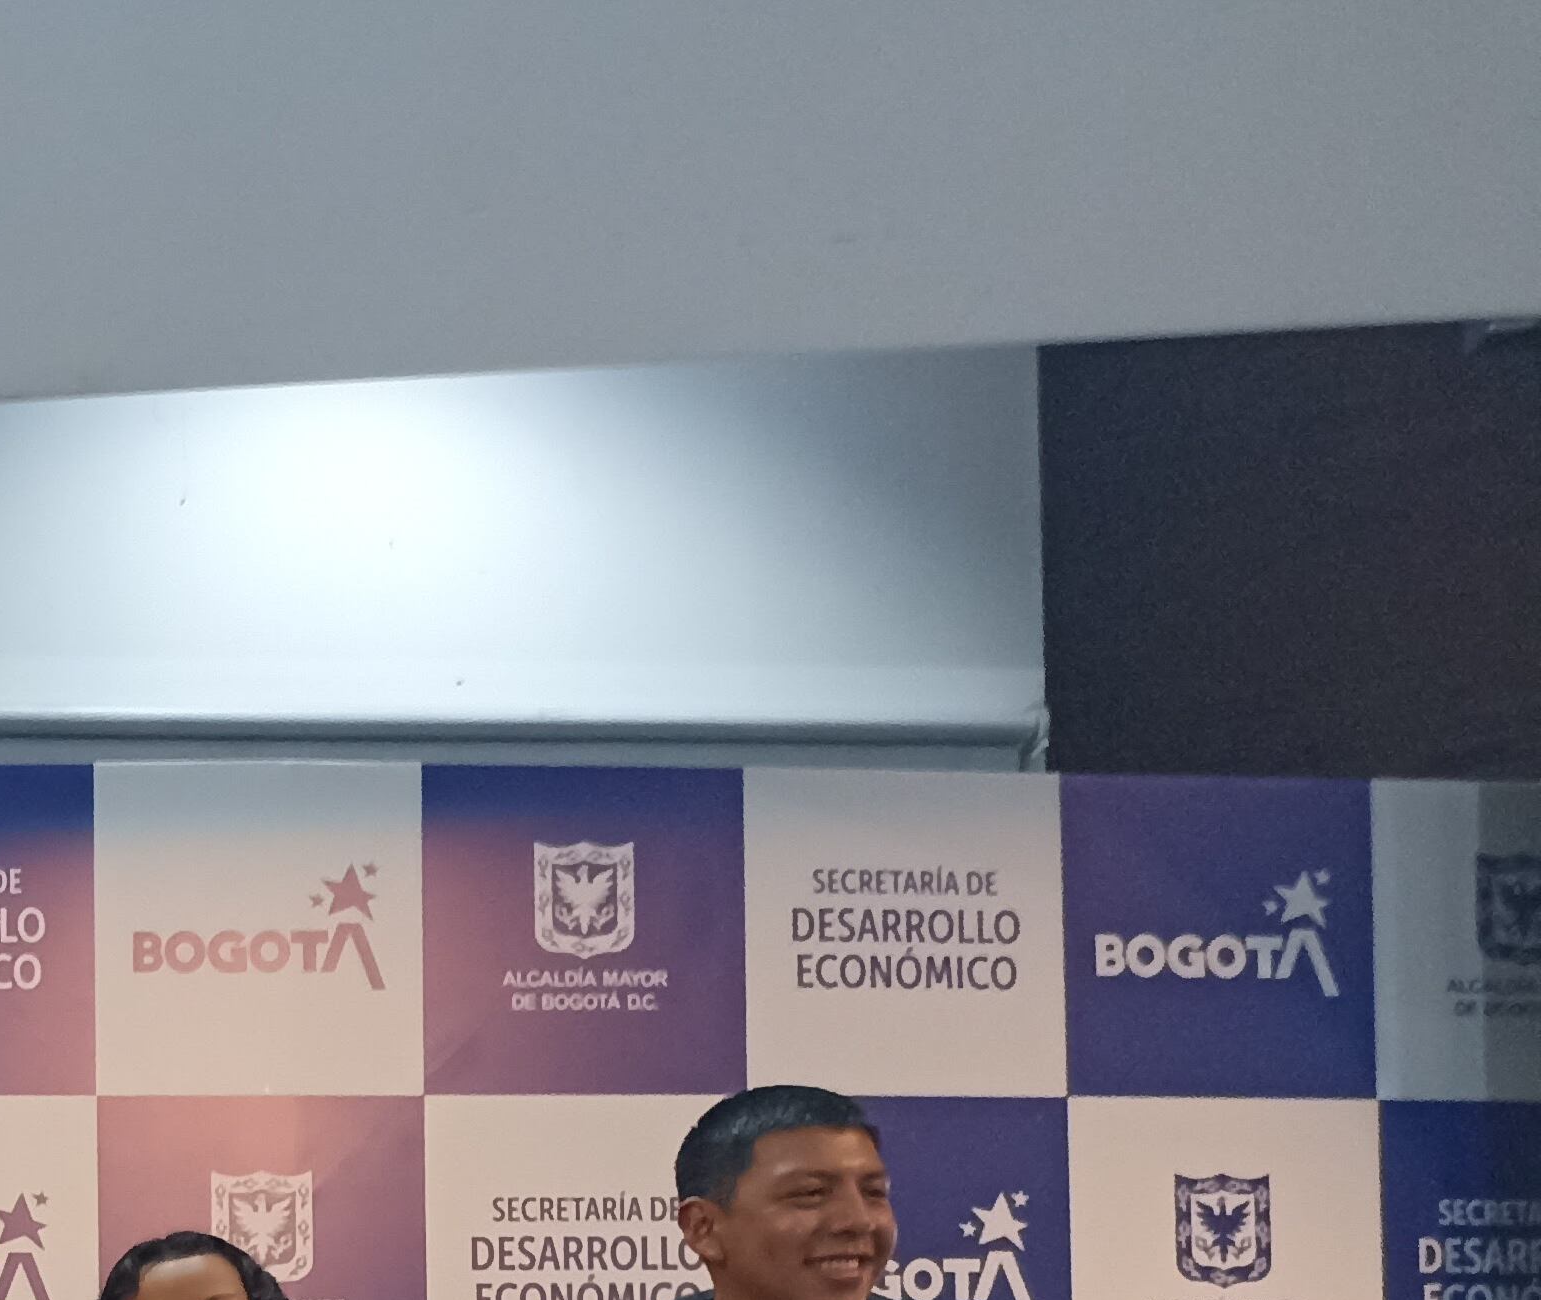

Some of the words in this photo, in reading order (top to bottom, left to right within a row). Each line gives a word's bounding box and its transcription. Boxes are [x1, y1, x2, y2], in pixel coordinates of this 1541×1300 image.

[813, 865, 959, 896] SECRETARÍA
[967, 871, 998, 897] DE
[792, 907, 1021, 945] DESARROLLO
[503, 967, 597, 988] ALCALDÍA
[603, 970, 668, 989] MAYOR
[796, 948, 1017, 991] ECONÓMICO
[511, 994, 536, 1010] DE
[541, 991, 620, 1011] BOGOTÁ
[492, 1191, 643, 1222] SECRETARÍA
[470, 1235, 702, 1272] DESARROLLO
